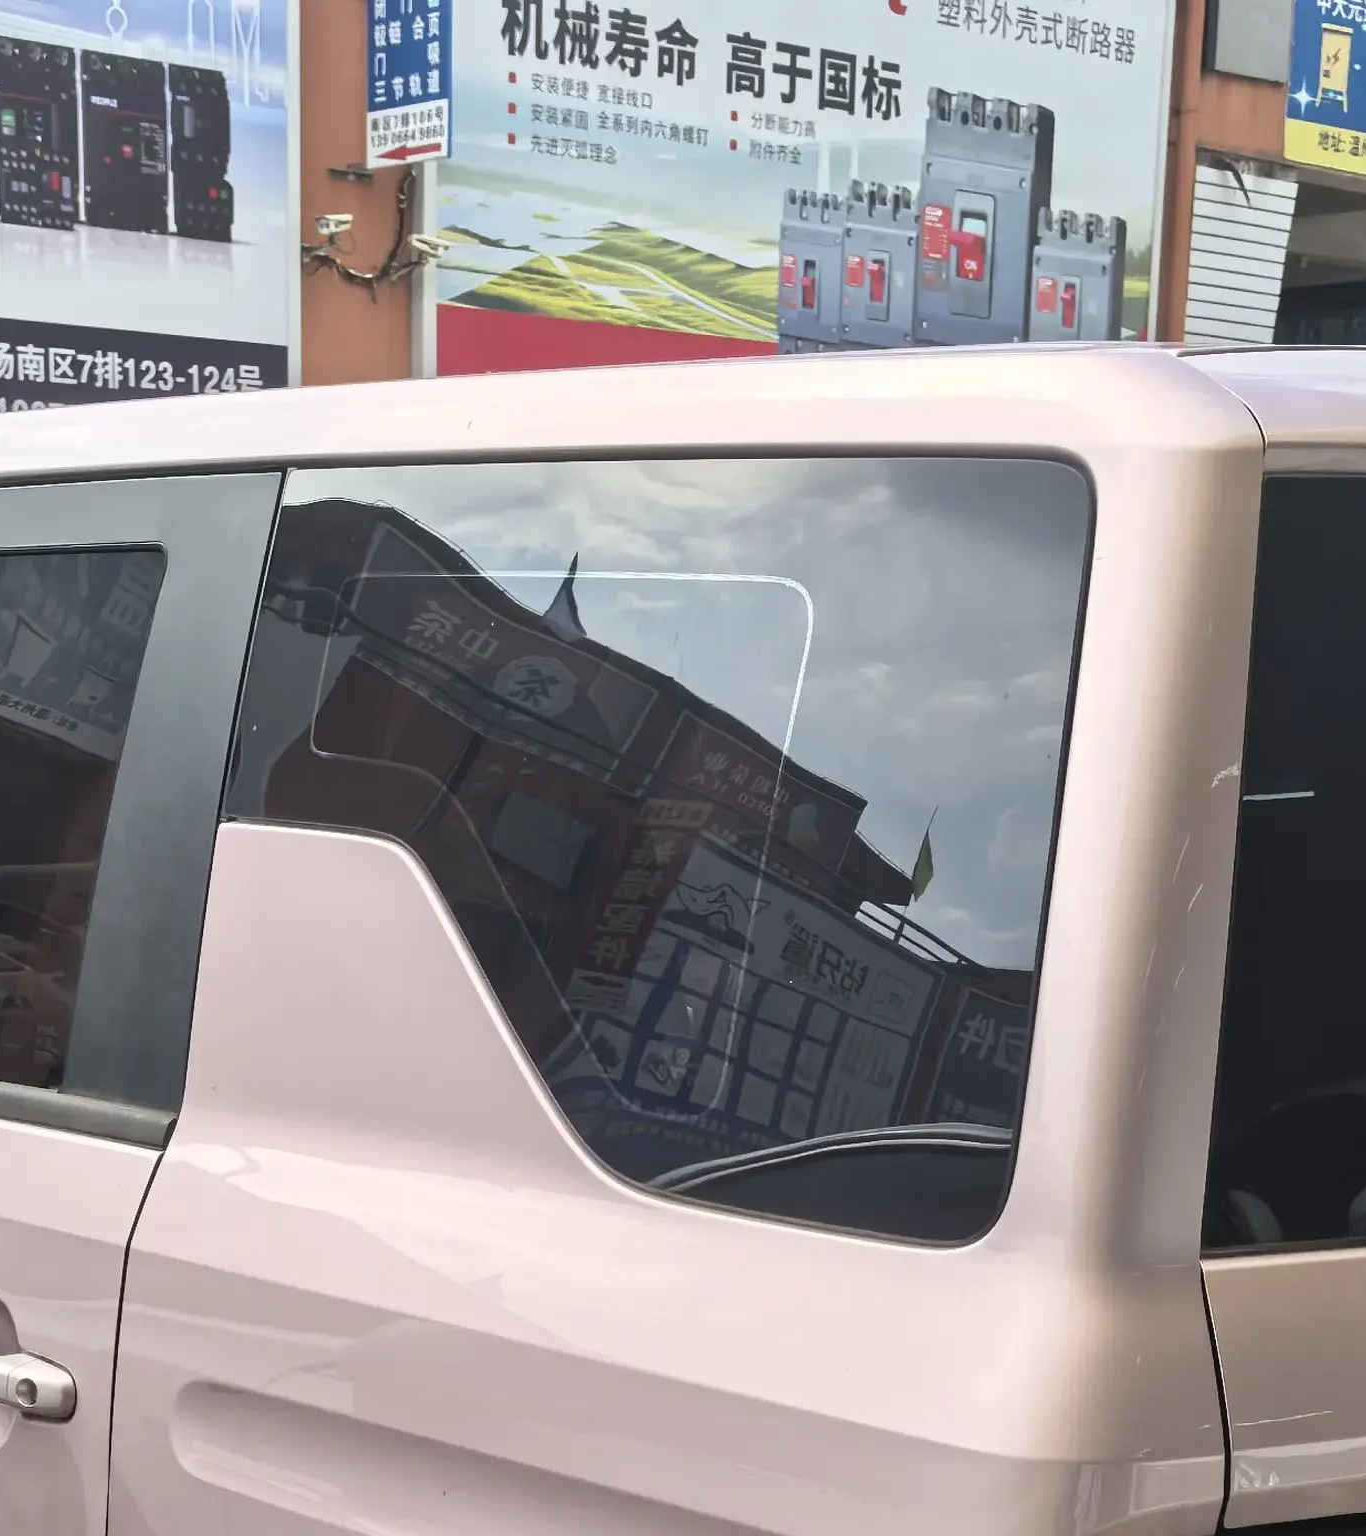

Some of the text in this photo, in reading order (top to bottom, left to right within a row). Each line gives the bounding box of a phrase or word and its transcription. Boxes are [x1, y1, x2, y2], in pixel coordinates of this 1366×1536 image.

[501, 0, 903, 121] 机械寿命 高于国标
